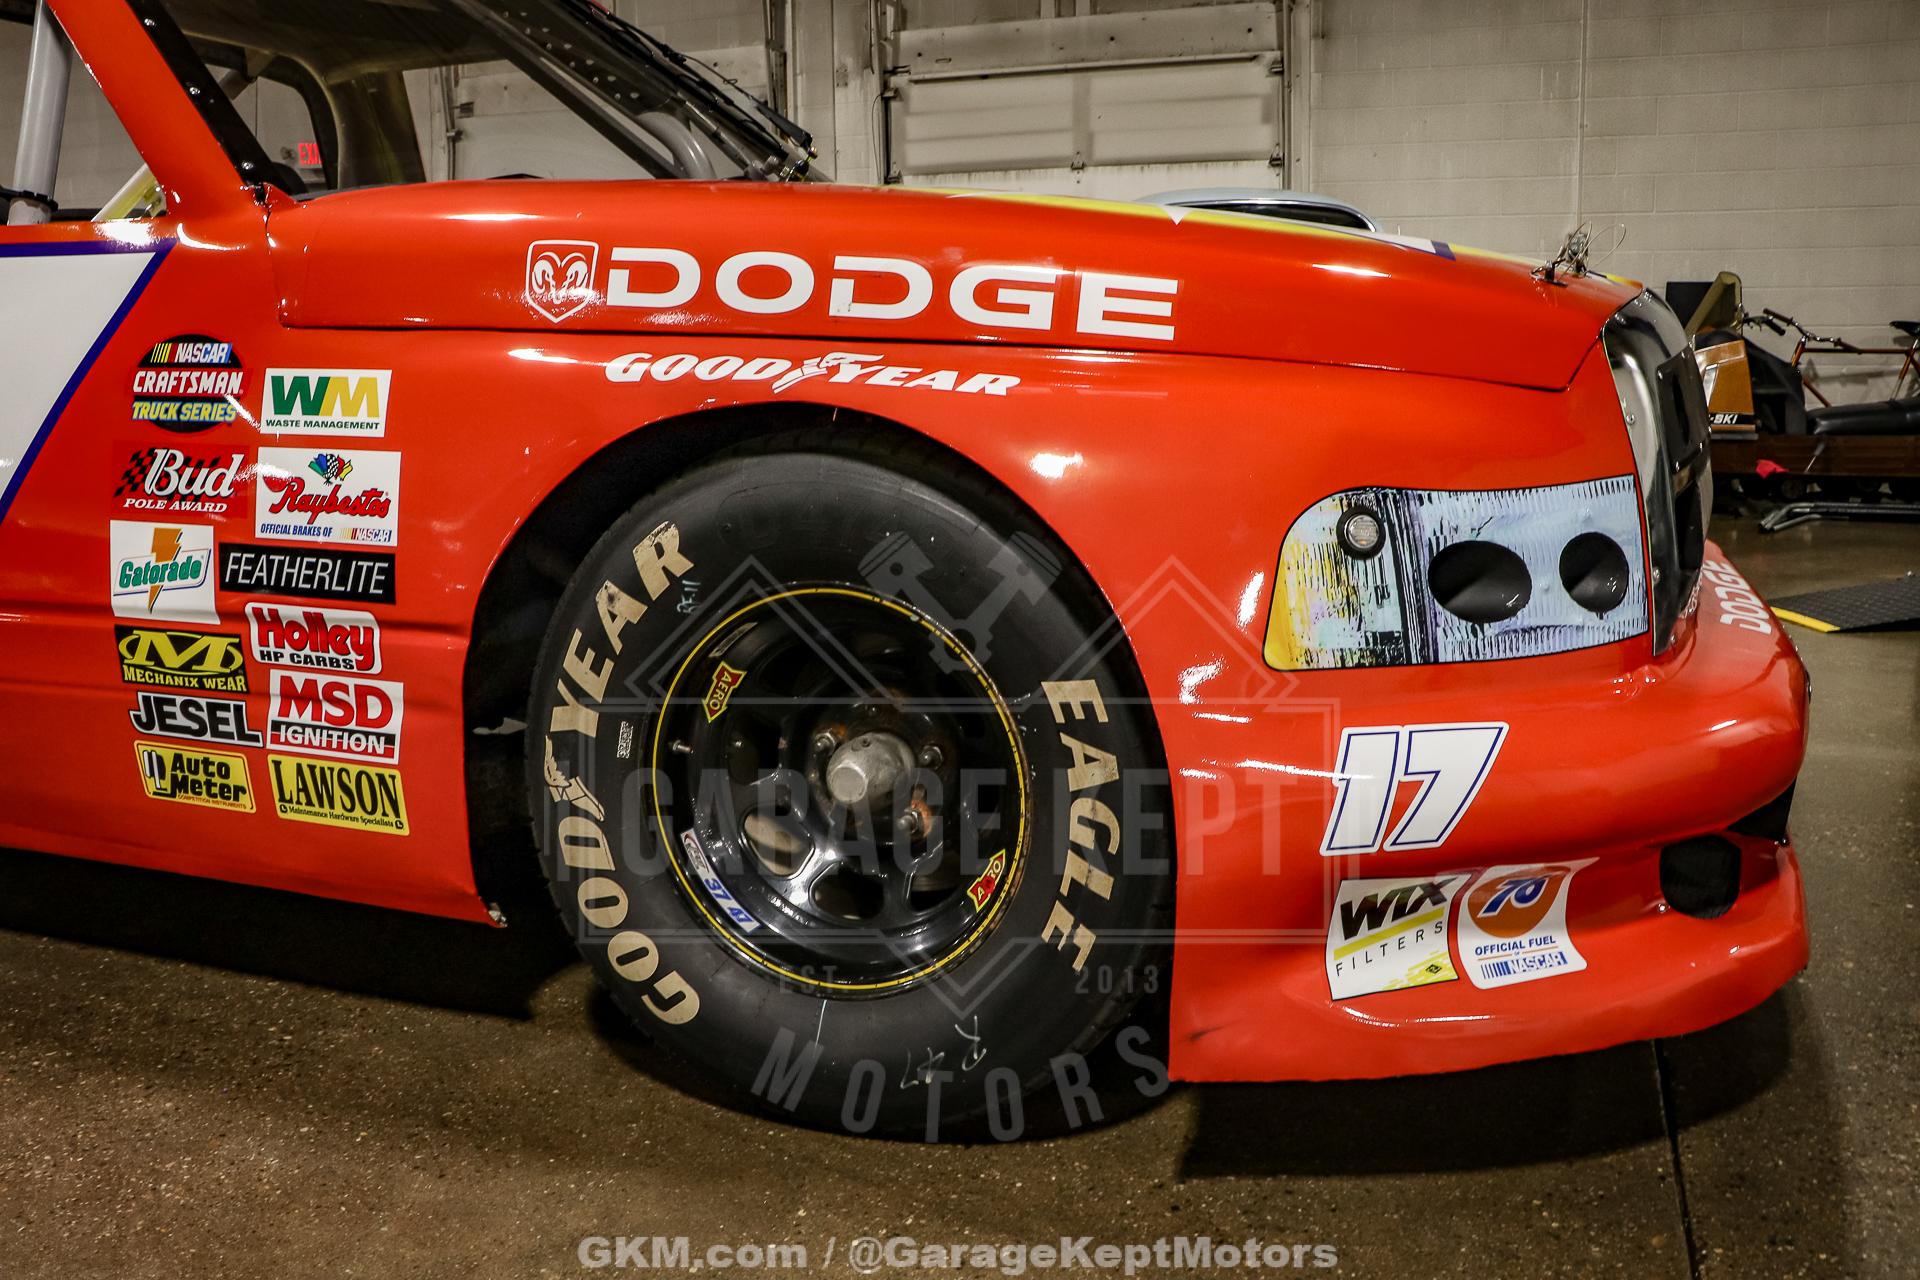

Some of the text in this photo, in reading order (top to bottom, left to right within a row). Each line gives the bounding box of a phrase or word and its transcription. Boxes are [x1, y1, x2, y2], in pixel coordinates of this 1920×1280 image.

[299, 143, 320, 165] EXI
[606, 247, 1179, 342] DODGE
[174, 342, 230, 364] NASCAR
[132, 370, 244, 395] CRAFTSMAN
[270, 375, 380, 418] WM
[131, 401, 237, 423] TRUCK SERIES
[265, 419, 380, 430] WASTE MANAGEMENT
[1708, 413, 1738, 425] -SKI
[144, 448, 245, 497] Bud
[122, 498, 228, 513] POLE AWARD
[263, 474, 392, 525] Raybestos
[260, 523, 392, 543] OFFICIAL BRAKES OF NASCAR
[119, 555, 201, 589] Gatorade
[225, 552, 390, 595] FEATHERLITE
[251, 606, 375, 671] Holley
[259, 650, 355, 670] HP CARBS
[122, 664, 247, 692] MECHANIX WEAR
[709, 670, 732, 711] AERO
[131, 693, 263, 746] JESEL
[277, 675, 394, 730] MSD
[279, 724, 386, 755] IGNITION
[171, 753, 231, 780] Auto
[170, 773, 247, 802] Meter
[271, 759, 401, 819] LAWSON
[1320, 722, 1509, 856] 17
[1041, 679, 1121, 973] EAGLE
[977, 860, 1001, 901] ARO
[1340, 877, 1458, 941] WIX
[1335, 921, 1444, 977] FILTERS
[1474, 935, 1557, 956] OFFICIAL FUEL
[1508, 952, 1567, 975] NASCAR
